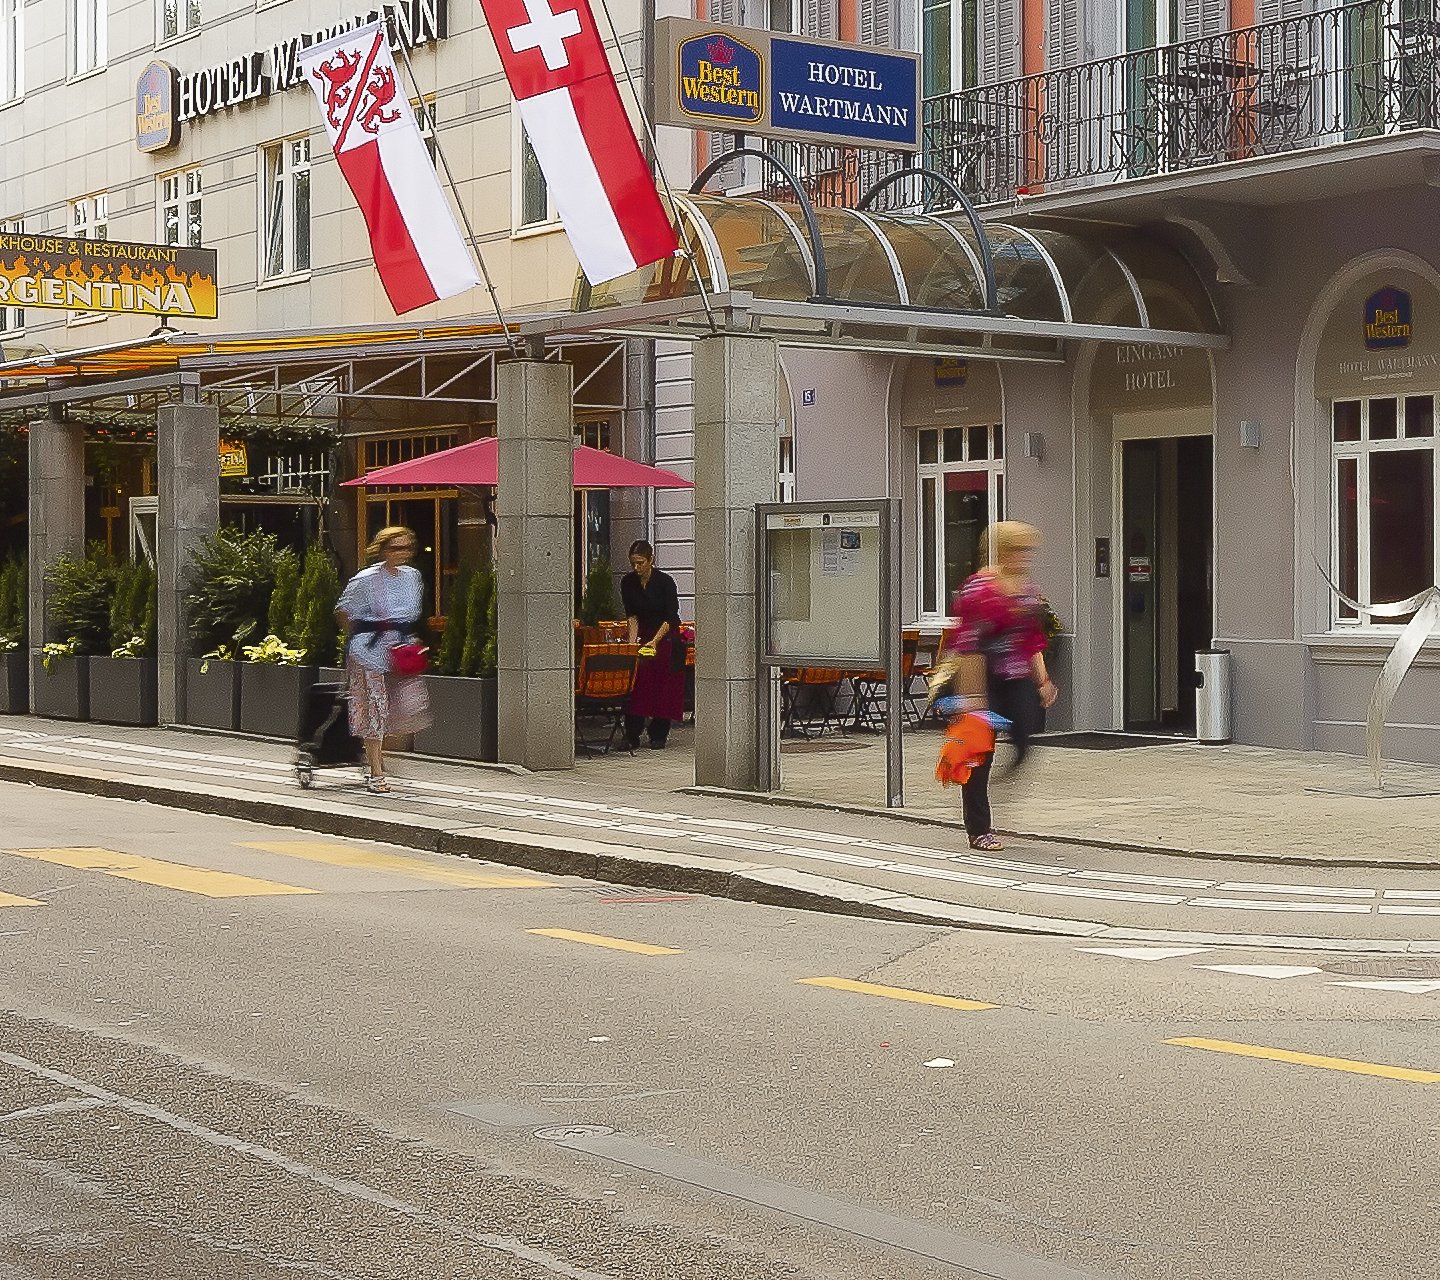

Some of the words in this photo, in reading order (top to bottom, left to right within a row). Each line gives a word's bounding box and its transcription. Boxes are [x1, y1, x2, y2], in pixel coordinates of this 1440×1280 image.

[177, 50, 266, 122] HOTEL
[698, 60, 741, 86] Best
[807, 62, 883, 91] HOTEL
[682, 76, 759, 108] Western
[778, 91, 909, 127] WARTMANN
[68, 242, 80, 256] &
[84, 243, 179, 263] RESTAURANT
[1375, 309, 1398, 324] Best
[1125, 369, 1176, 391] HOTEL
